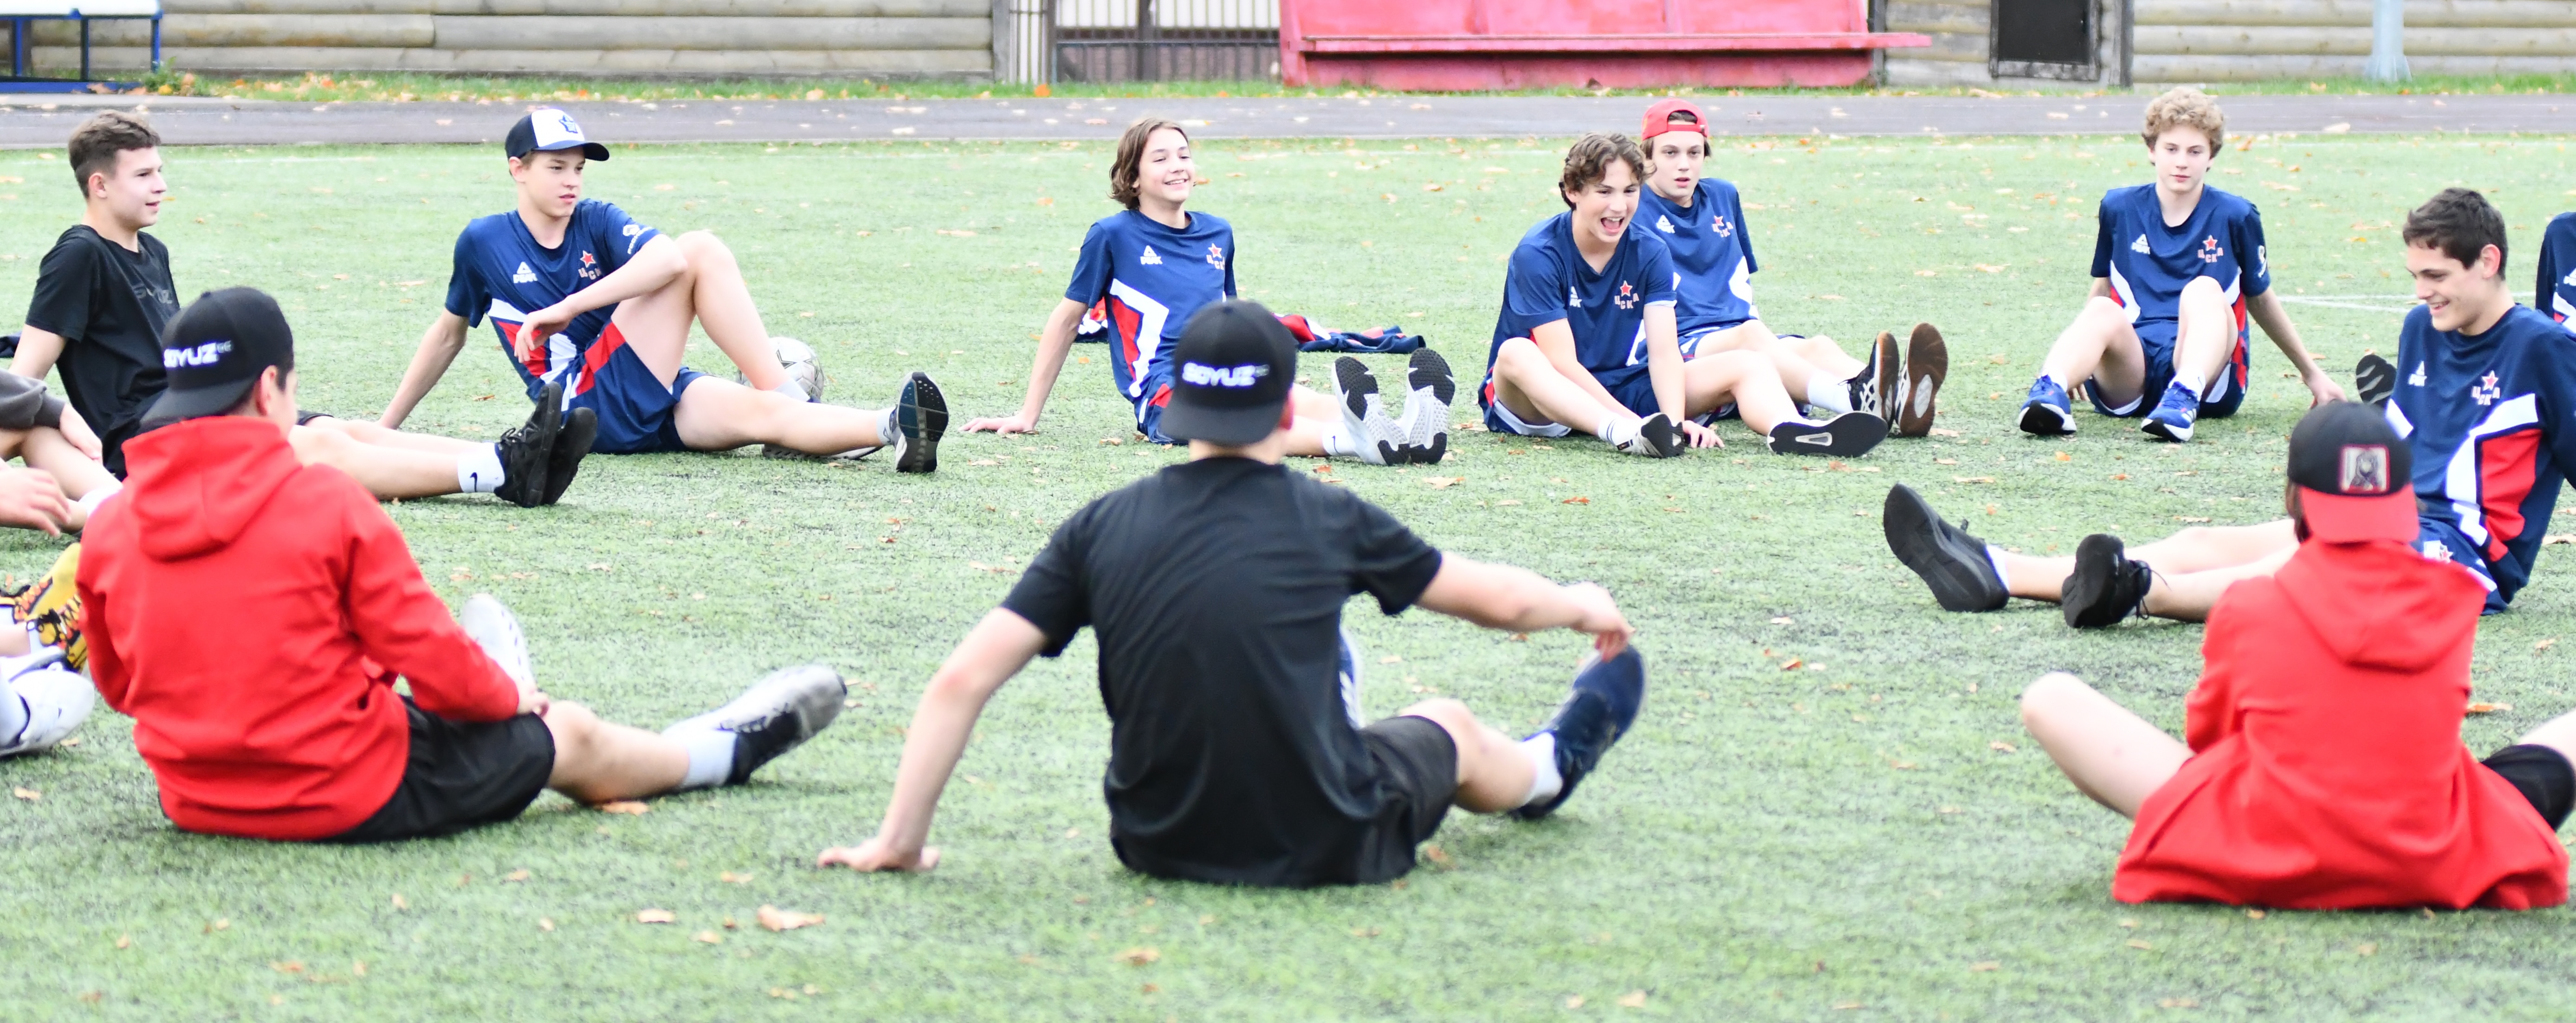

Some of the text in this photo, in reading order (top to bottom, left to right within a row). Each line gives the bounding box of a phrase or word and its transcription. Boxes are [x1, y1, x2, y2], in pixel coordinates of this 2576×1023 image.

[1206, 255, 1225, 270] ЦСК
[2198, 247, 2223, 263] ЦСКА
[578, 267, 602, 280] ЦСК
[1614, 293, 1639, 310] ЦСКА
[1182, 363, 1256, 387] SOYUZ
[2471, 386, 2500, 406] ЦСКА
